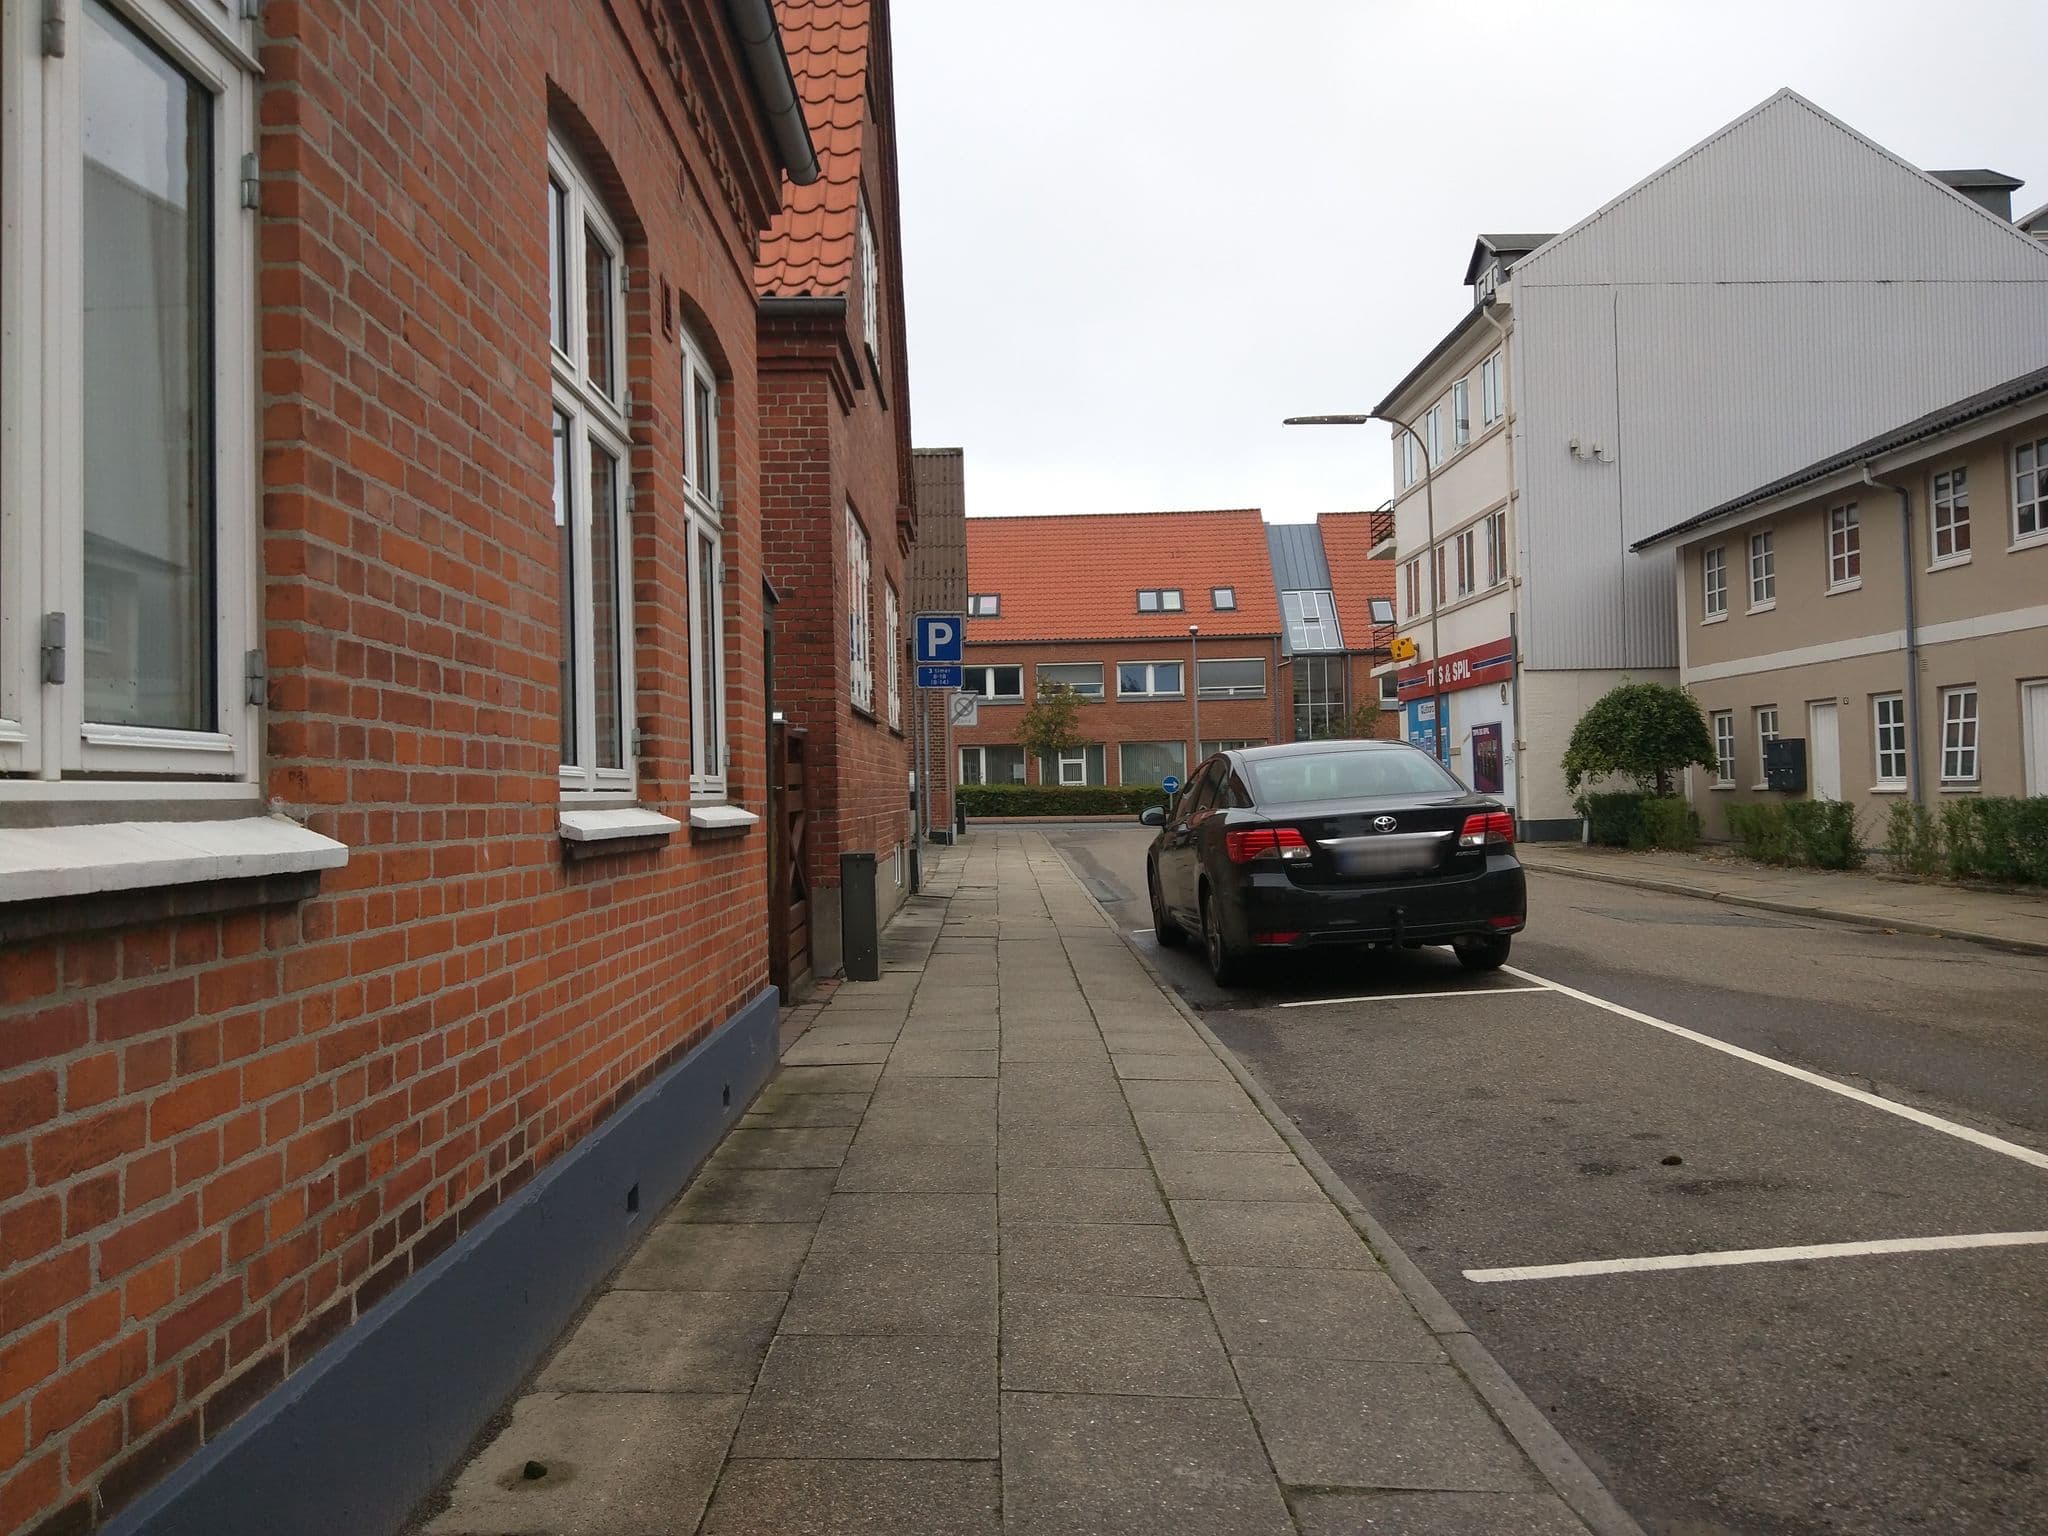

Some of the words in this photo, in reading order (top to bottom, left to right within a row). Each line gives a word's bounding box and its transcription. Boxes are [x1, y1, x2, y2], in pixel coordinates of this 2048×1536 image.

[928, 622, 953, 657] P
[1427, 665, 1444, 688] TIS
[1445, 663, 1451, 683] &
[1452, 659, 1471, 681] SPIL
